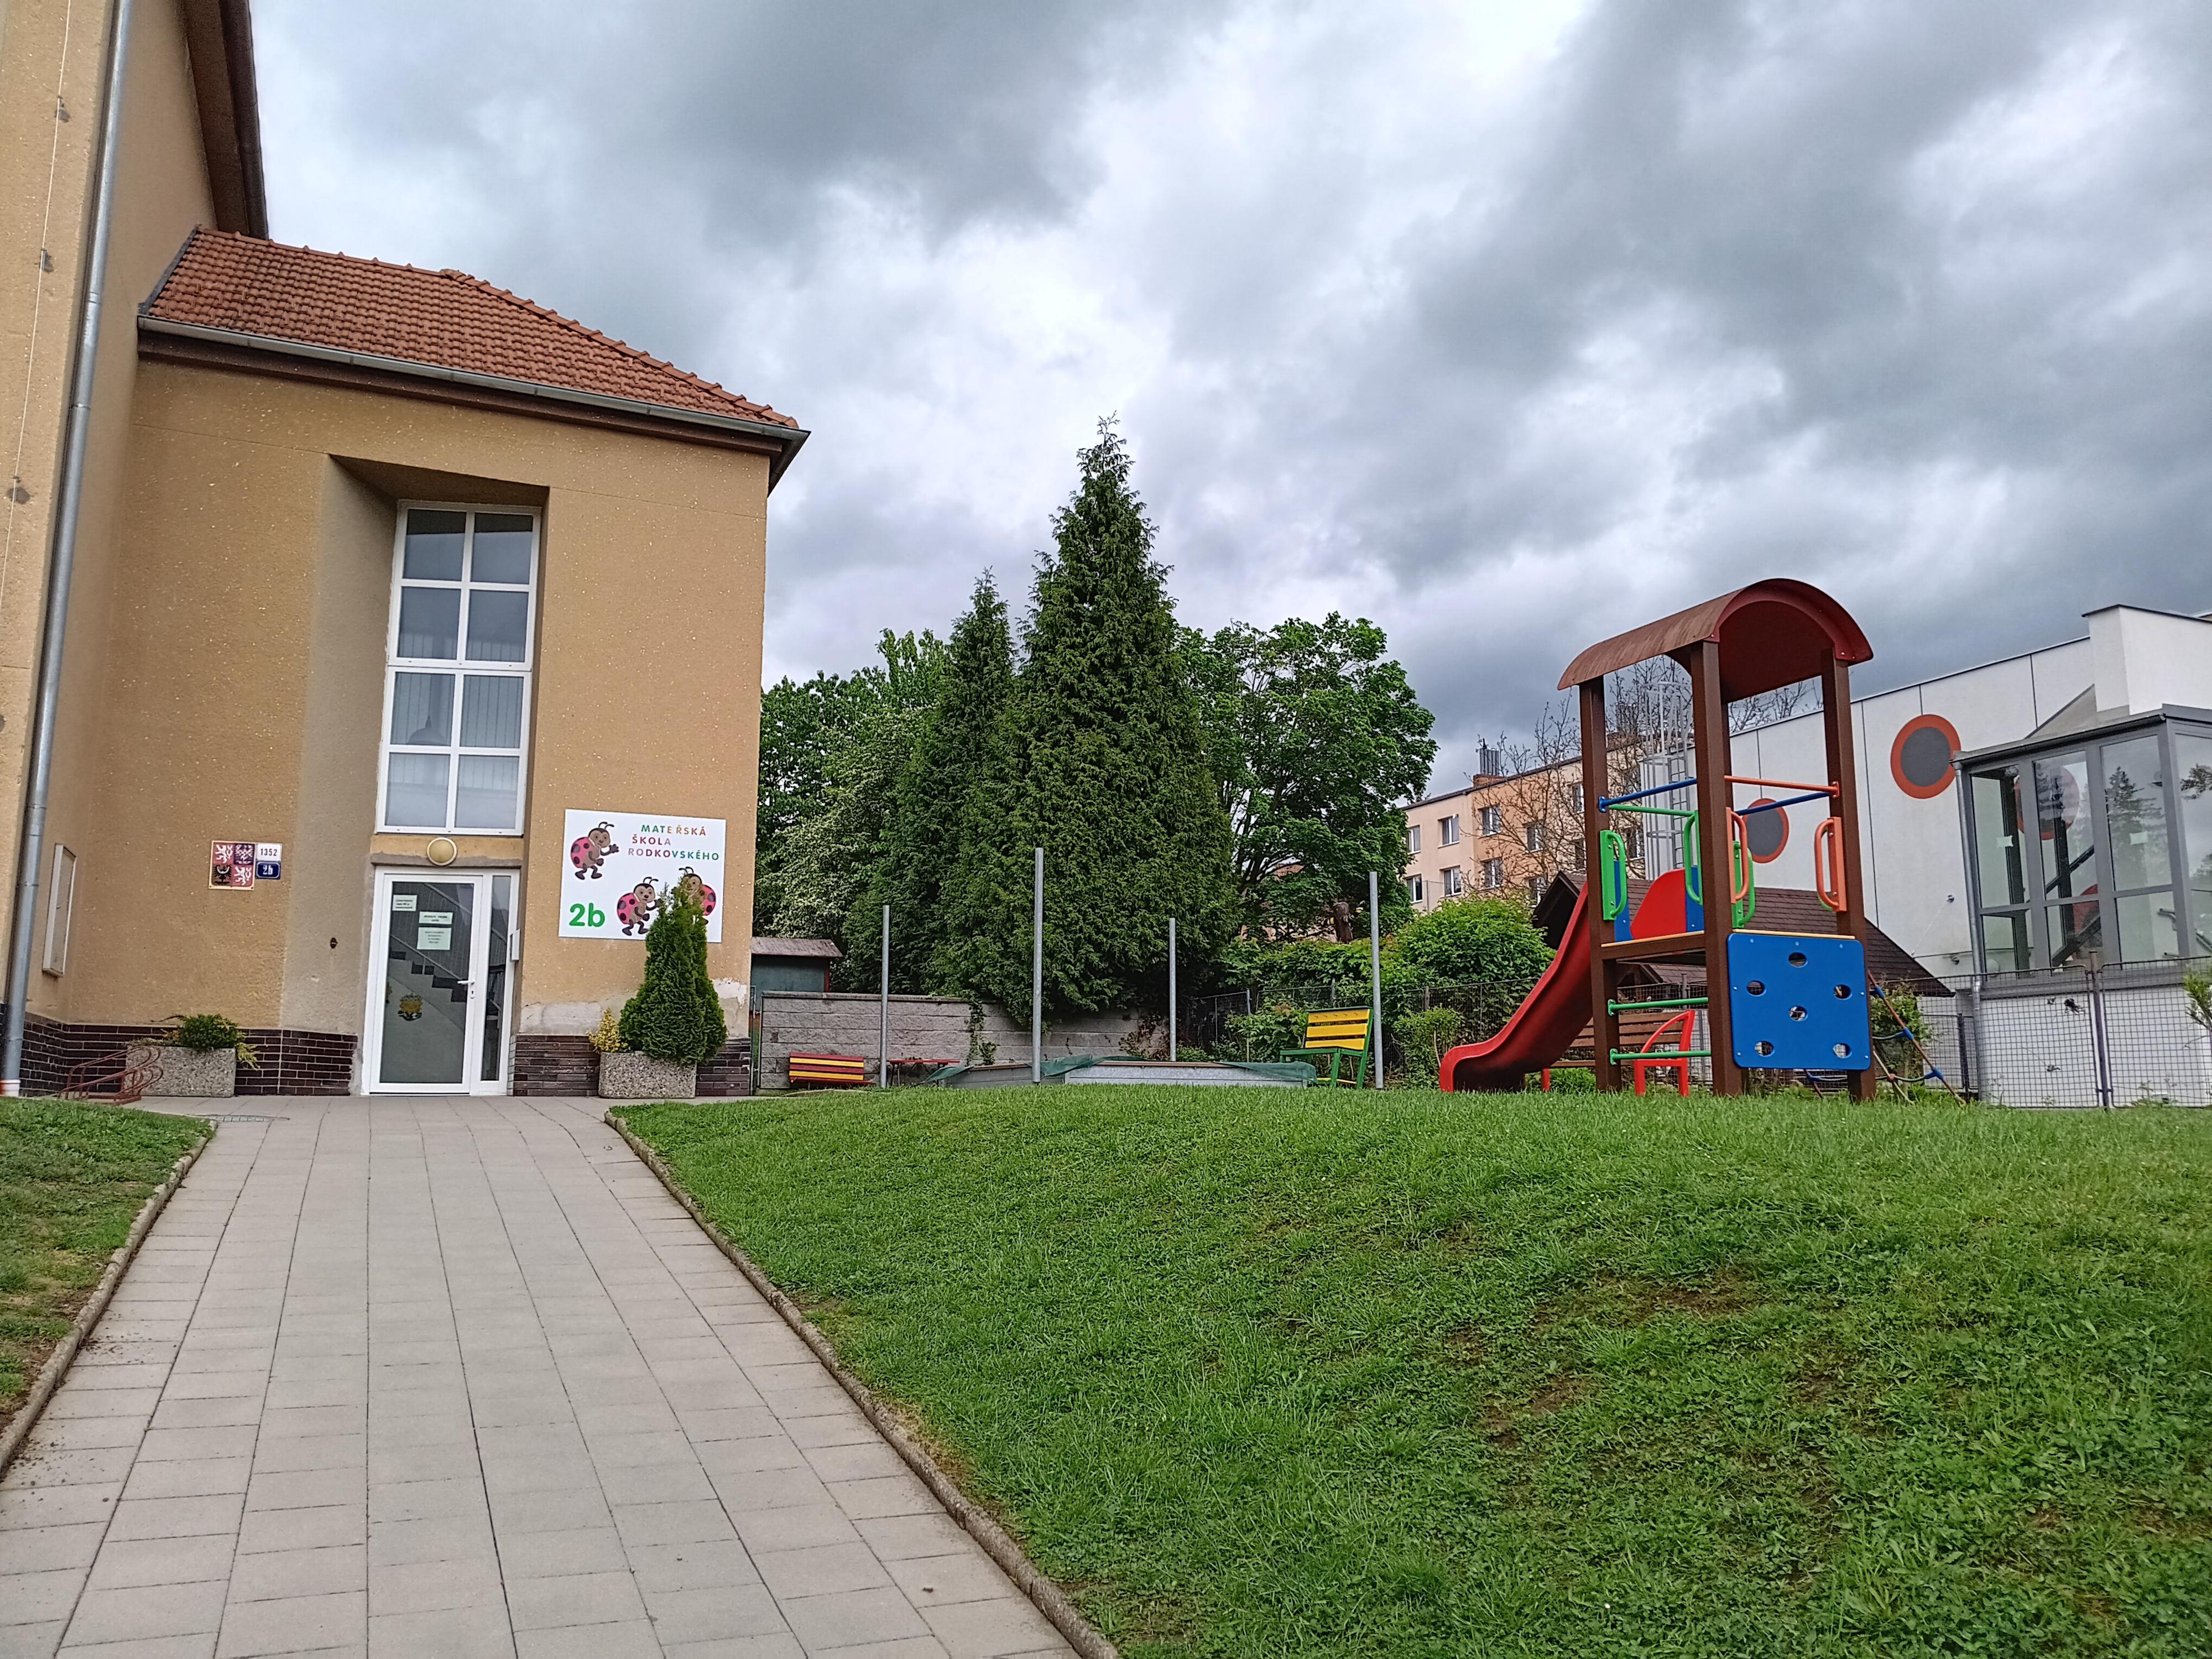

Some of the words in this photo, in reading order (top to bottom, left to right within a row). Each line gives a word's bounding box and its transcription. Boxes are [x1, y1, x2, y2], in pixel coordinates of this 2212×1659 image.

[641, 825, 706, 836] MATEŘSKÁ
[632, 834, 671, 846] ŠKOLA
[628, 848, 719, 860] RODKOVSKÉHO
[262, 864, 273, 875] 2b
[568, 902, 606, 927] 2b
